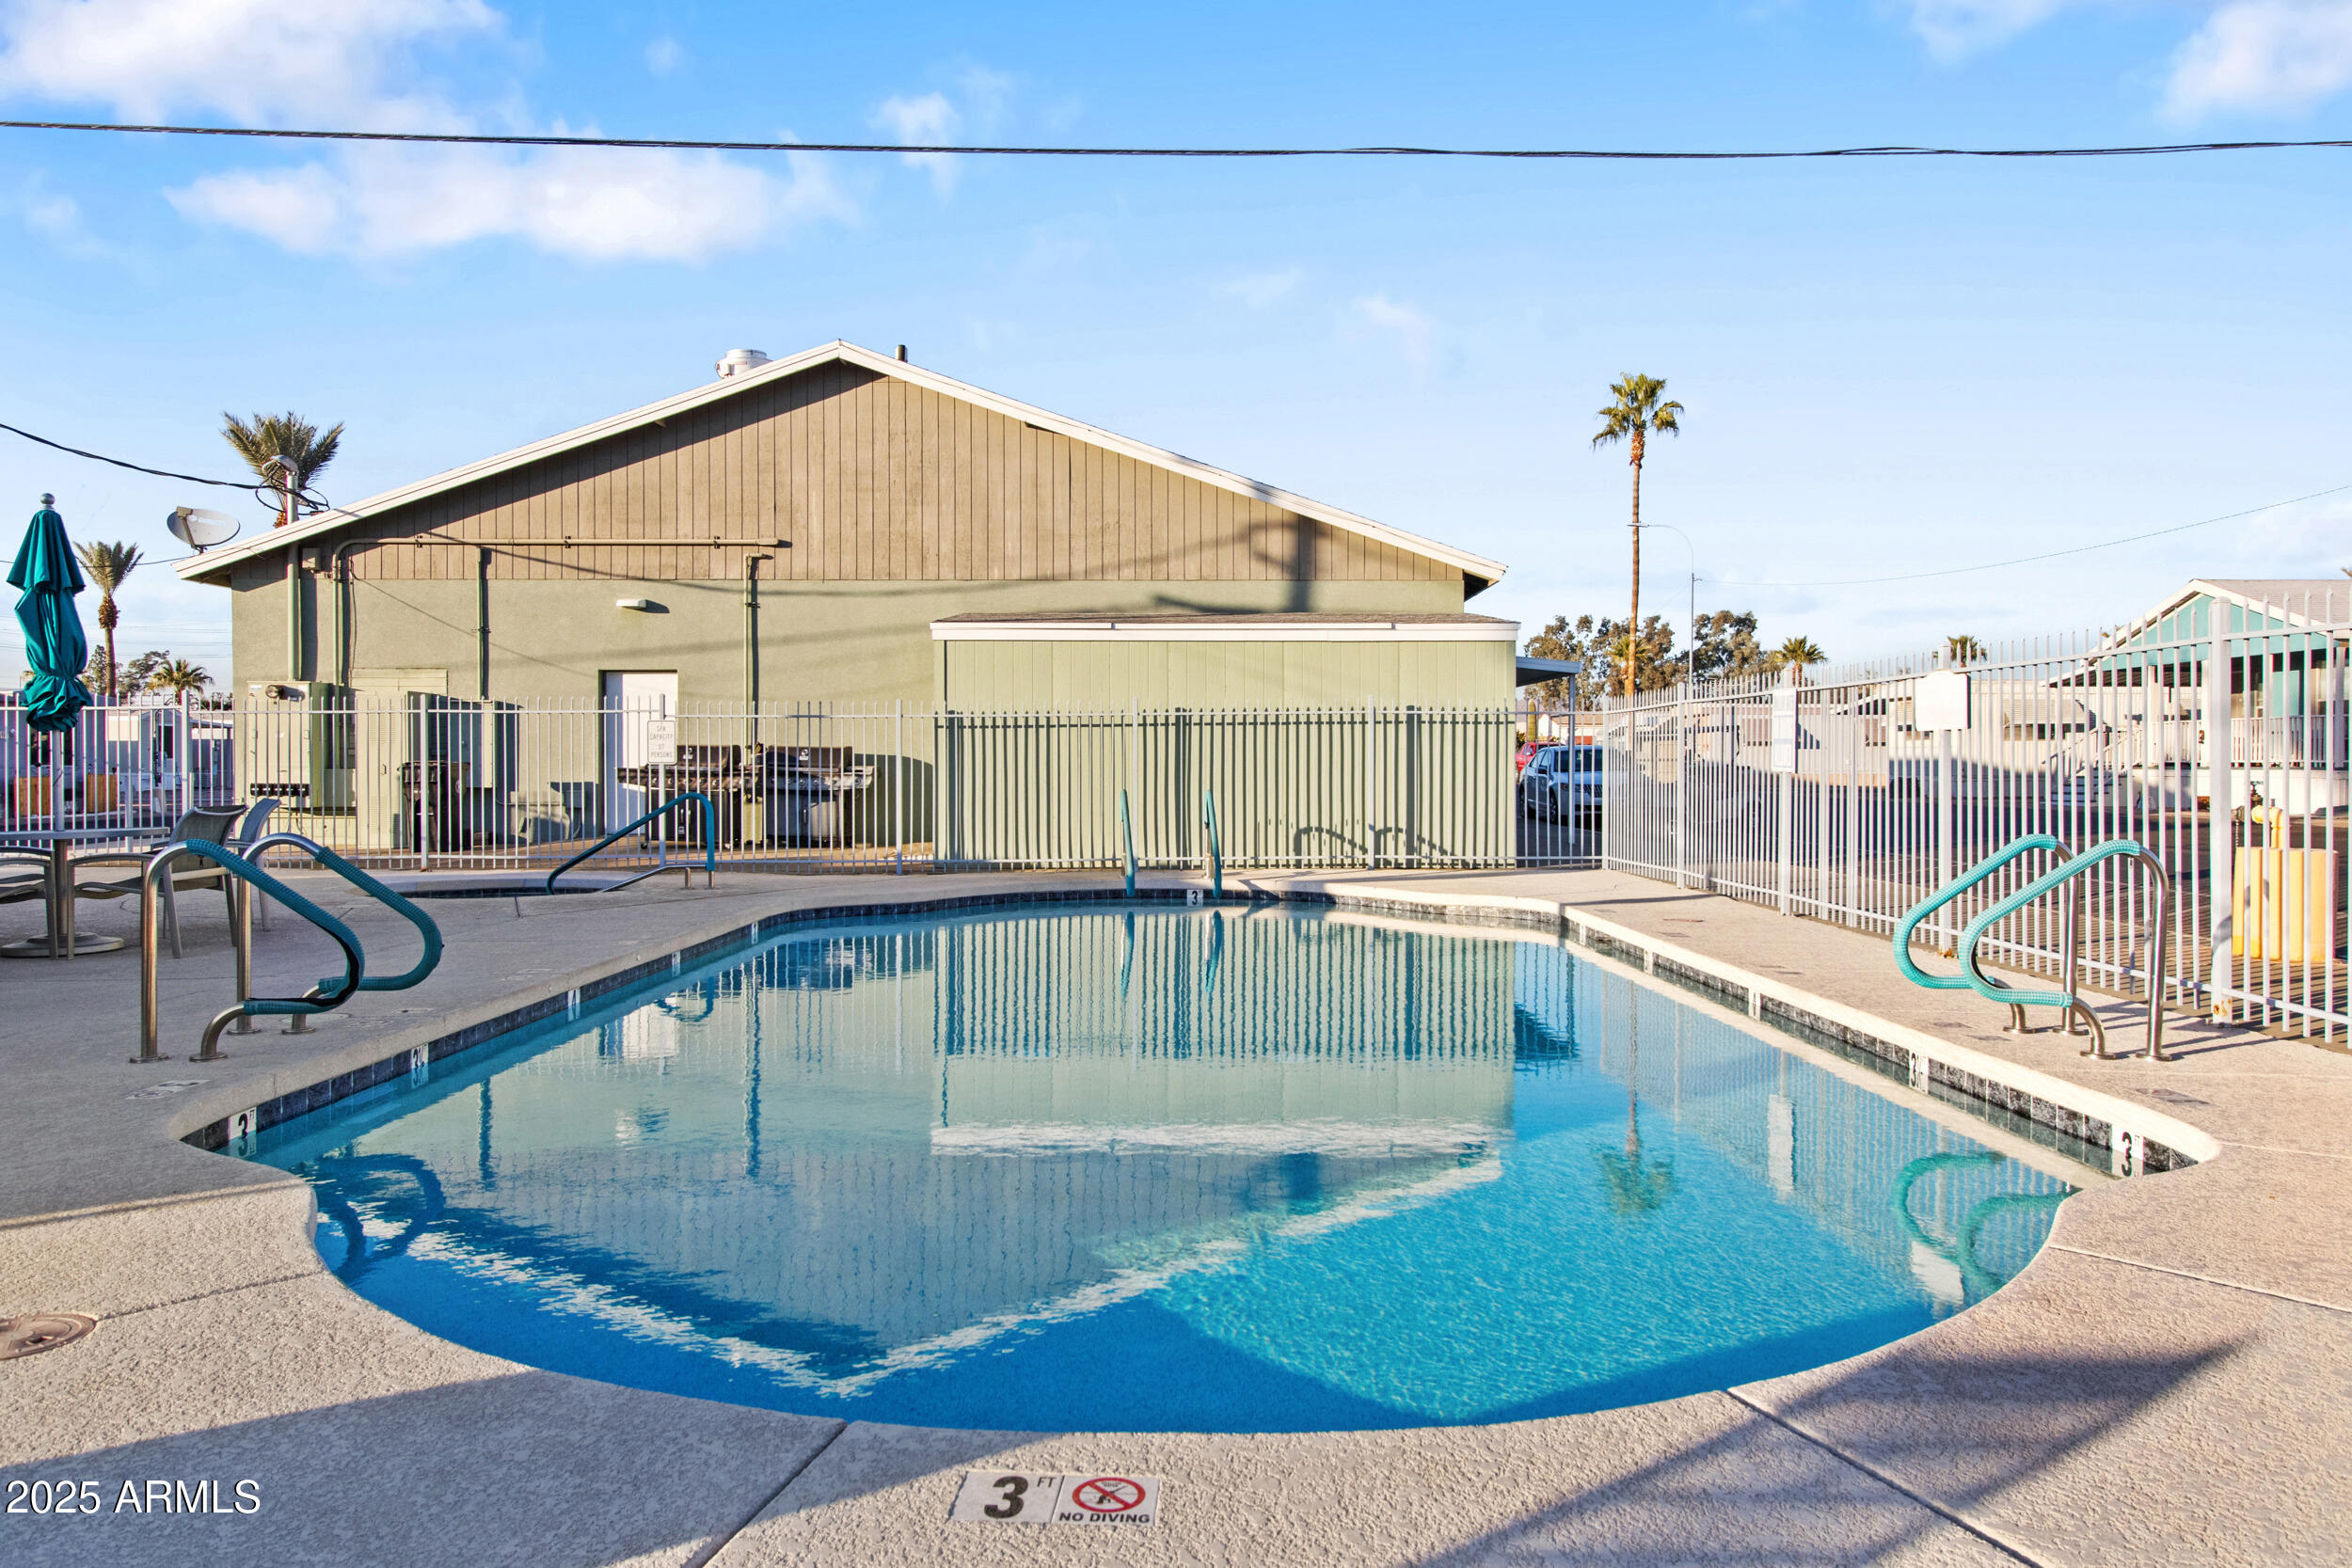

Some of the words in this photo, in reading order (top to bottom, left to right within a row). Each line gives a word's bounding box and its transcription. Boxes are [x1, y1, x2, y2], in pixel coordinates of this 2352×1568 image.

[984, 1475, 1028, 1519] 3
[1037, 1476, 1057, 1488] FT
[1058, 1512, 1084, 1522] NO
[1089, 1513, 1151, 1524] DIVING
